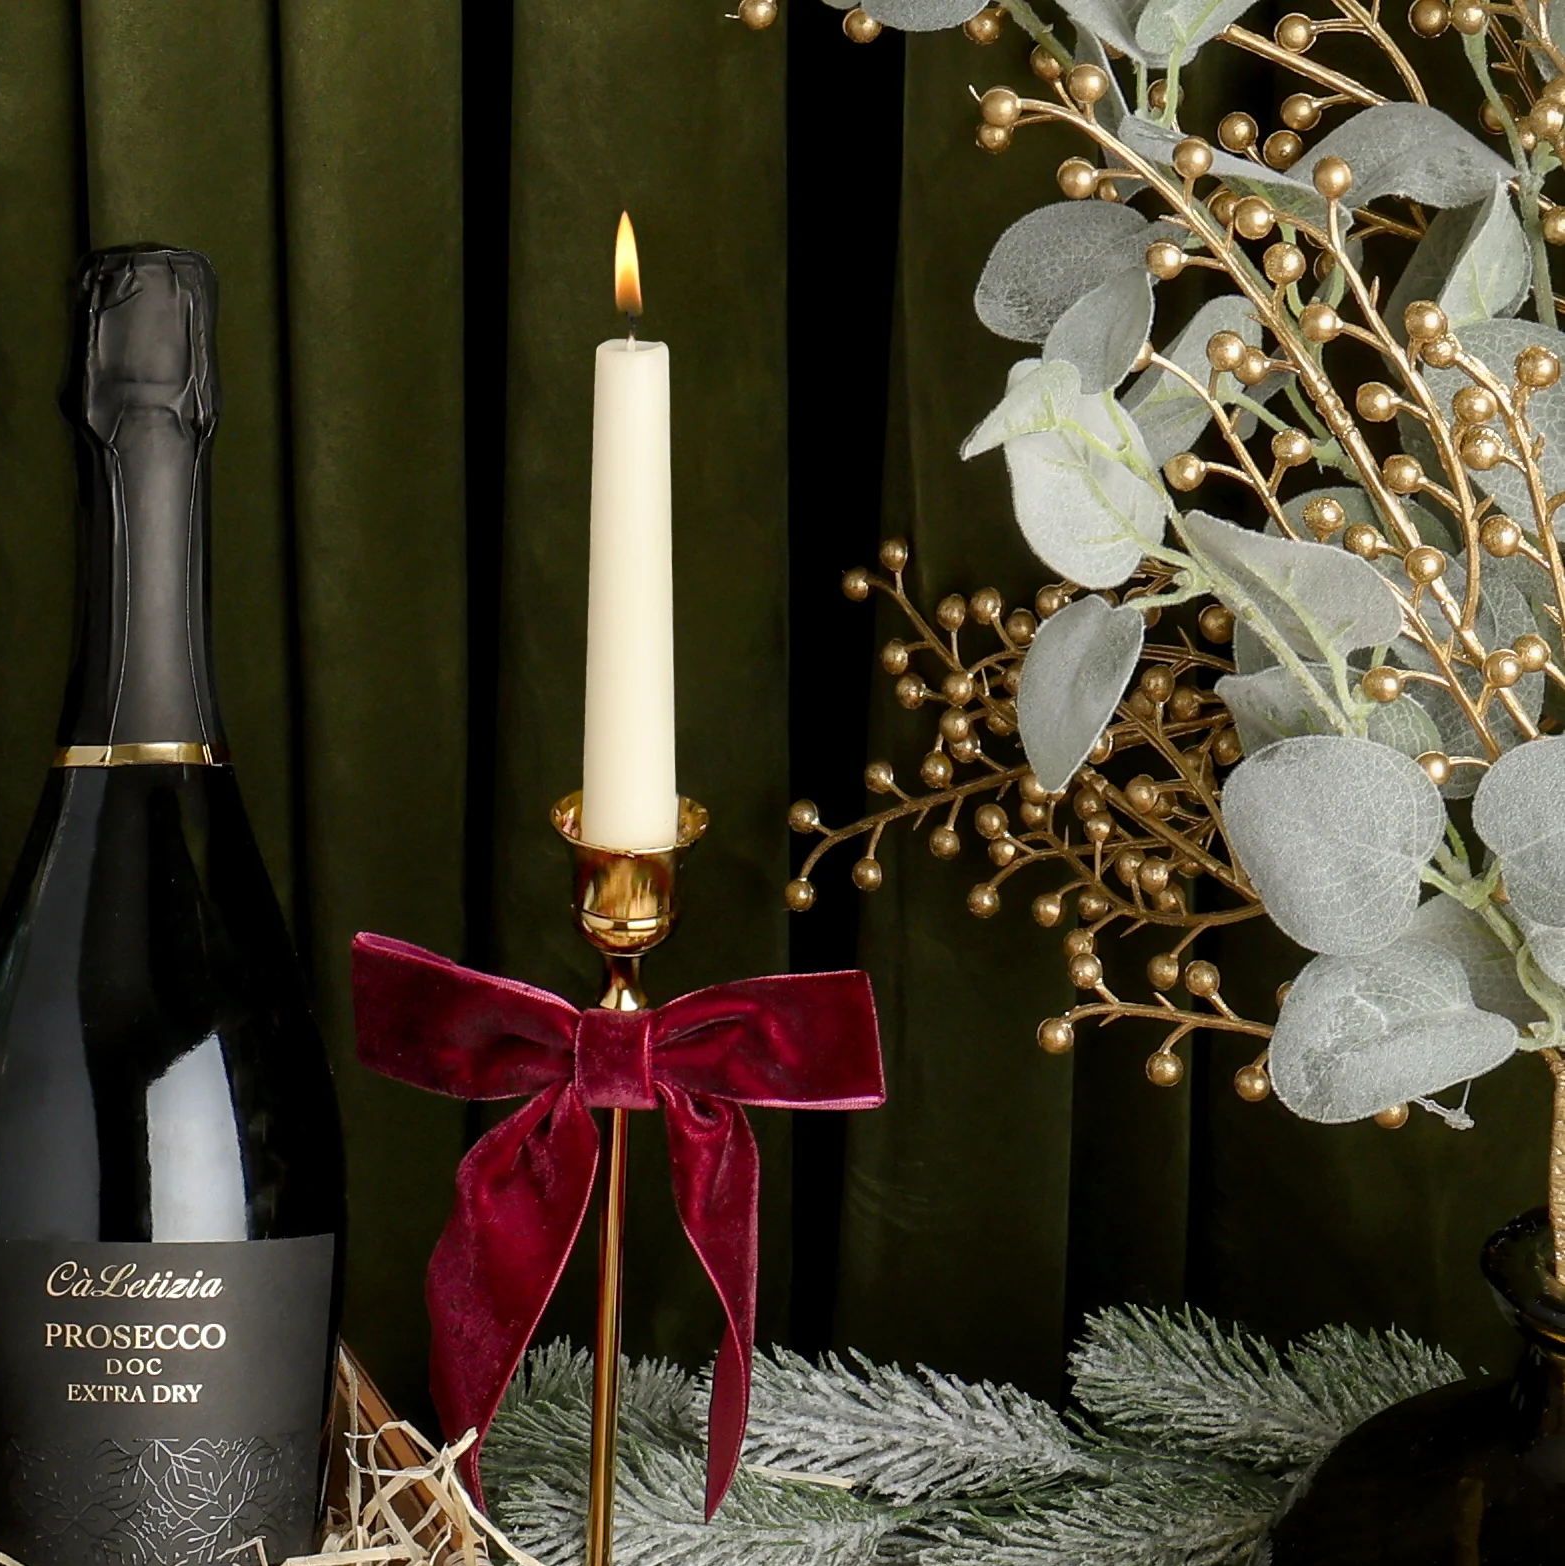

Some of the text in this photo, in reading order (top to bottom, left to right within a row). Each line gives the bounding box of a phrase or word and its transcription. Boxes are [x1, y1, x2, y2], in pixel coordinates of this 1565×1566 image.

[44, 1322, 227, 1350] PROSECCO
[106, 1357, 163, 1376] DOC
[67, 1384, 203, 1403] EXTRA DRY
